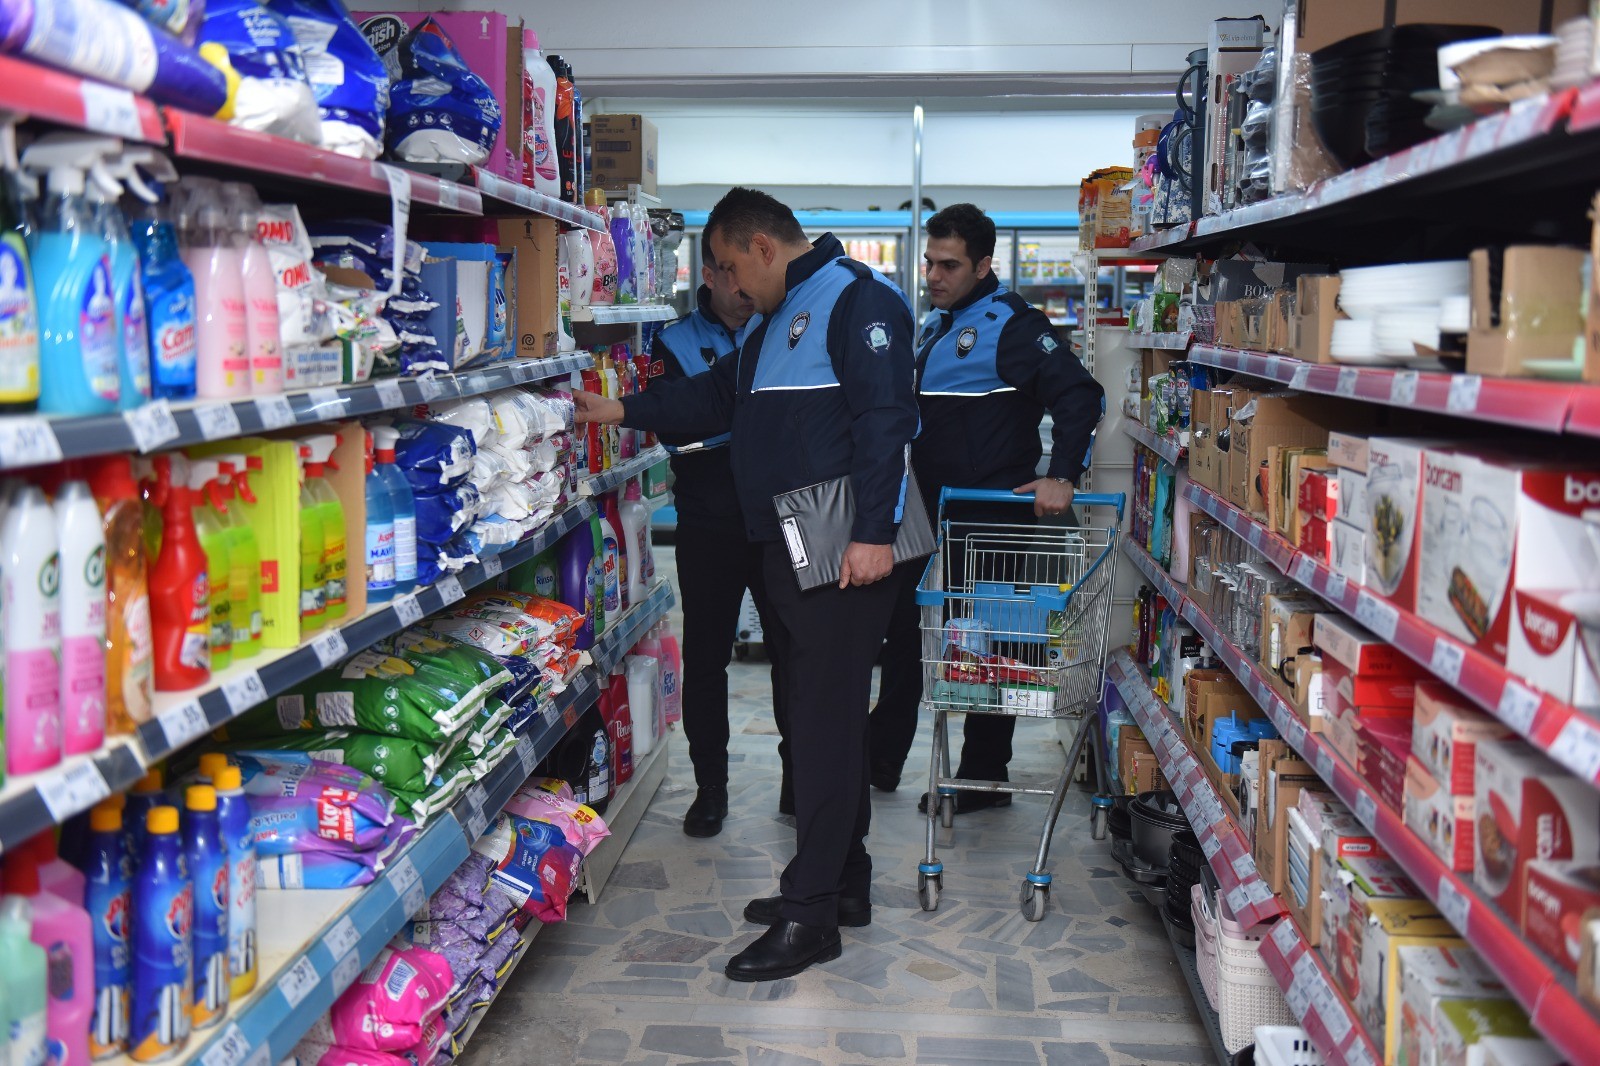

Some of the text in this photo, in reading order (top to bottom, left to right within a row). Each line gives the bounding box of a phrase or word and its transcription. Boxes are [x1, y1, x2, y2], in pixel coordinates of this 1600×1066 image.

[366, 20, 395, 47] nish
[375, 42, 391, 53] ction
[534, 141, 549, 152] ingo
[1564, 476, 1600, 503] bo
[536, 573, 554, 585] Rinso
